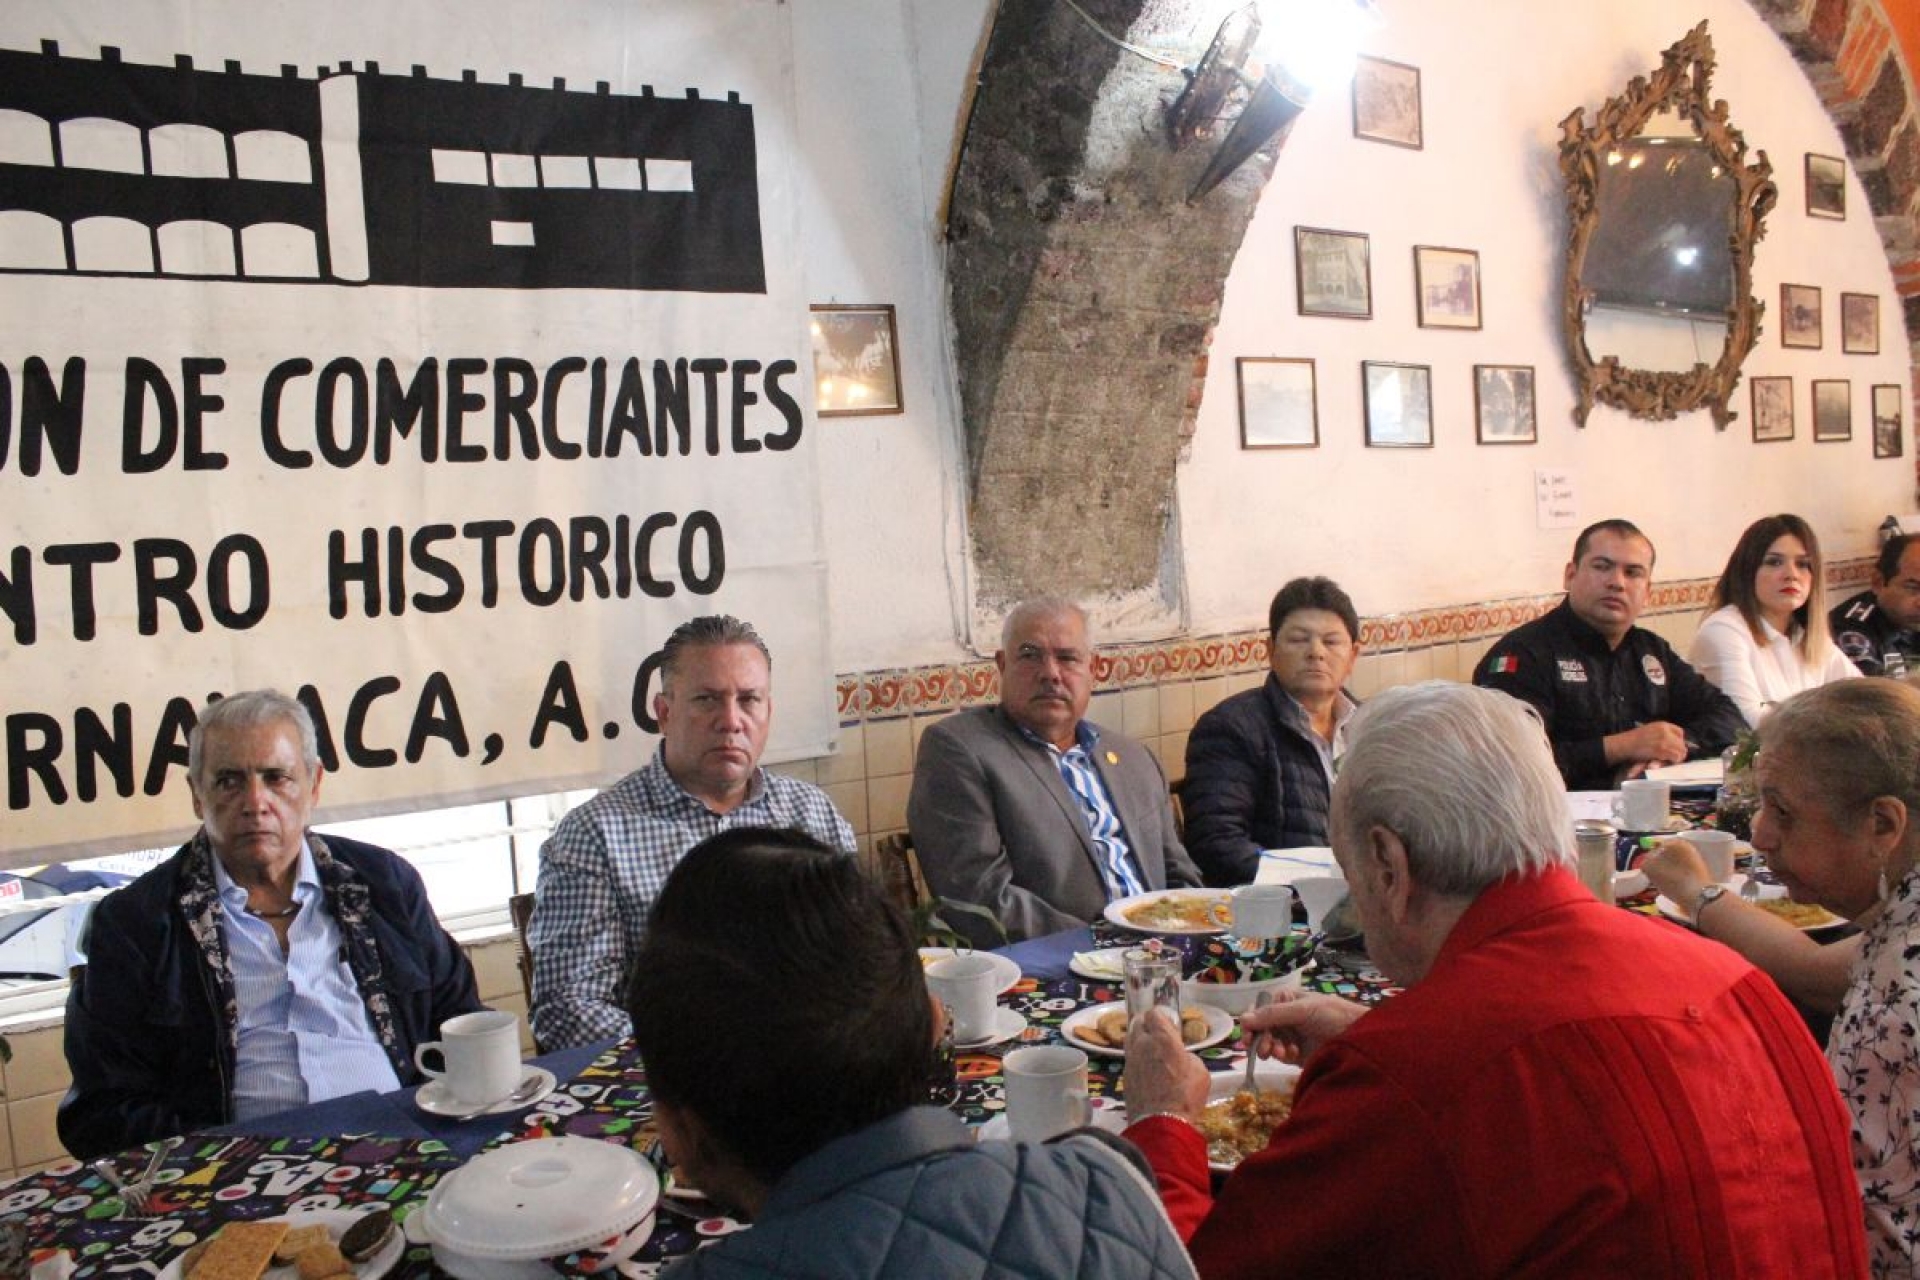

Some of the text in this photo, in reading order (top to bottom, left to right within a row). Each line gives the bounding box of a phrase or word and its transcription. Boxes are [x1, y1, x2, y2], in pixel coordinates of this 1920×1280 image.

[0, 356, 803, 478] N DE COMERCIANTES
[328, 510, 726, 620] HISTORICO
